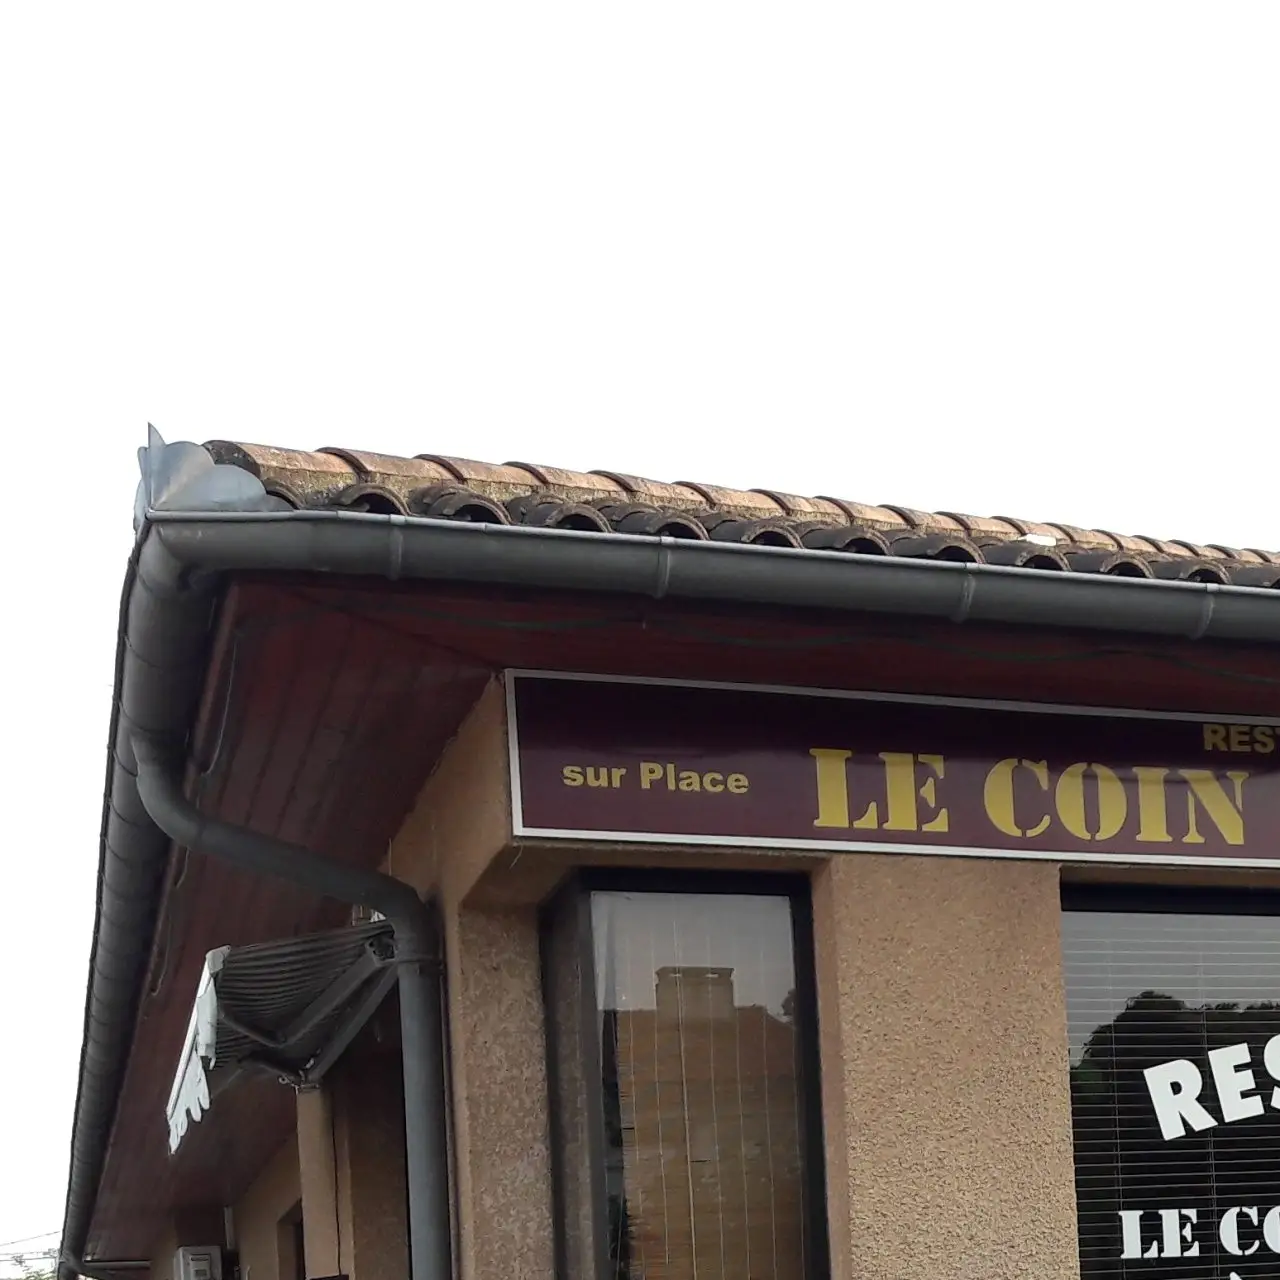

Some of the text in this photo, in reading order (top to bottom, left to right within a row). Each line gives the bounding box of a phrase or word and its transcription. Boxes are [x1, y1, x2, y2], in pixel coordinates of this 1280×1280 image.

[562, 761, 750, 794] sur Place
[809, 747, 950, 833] LE
[983, 757, 1248, 848] COIN
[1118, 1208, 1200, 1259] LE
